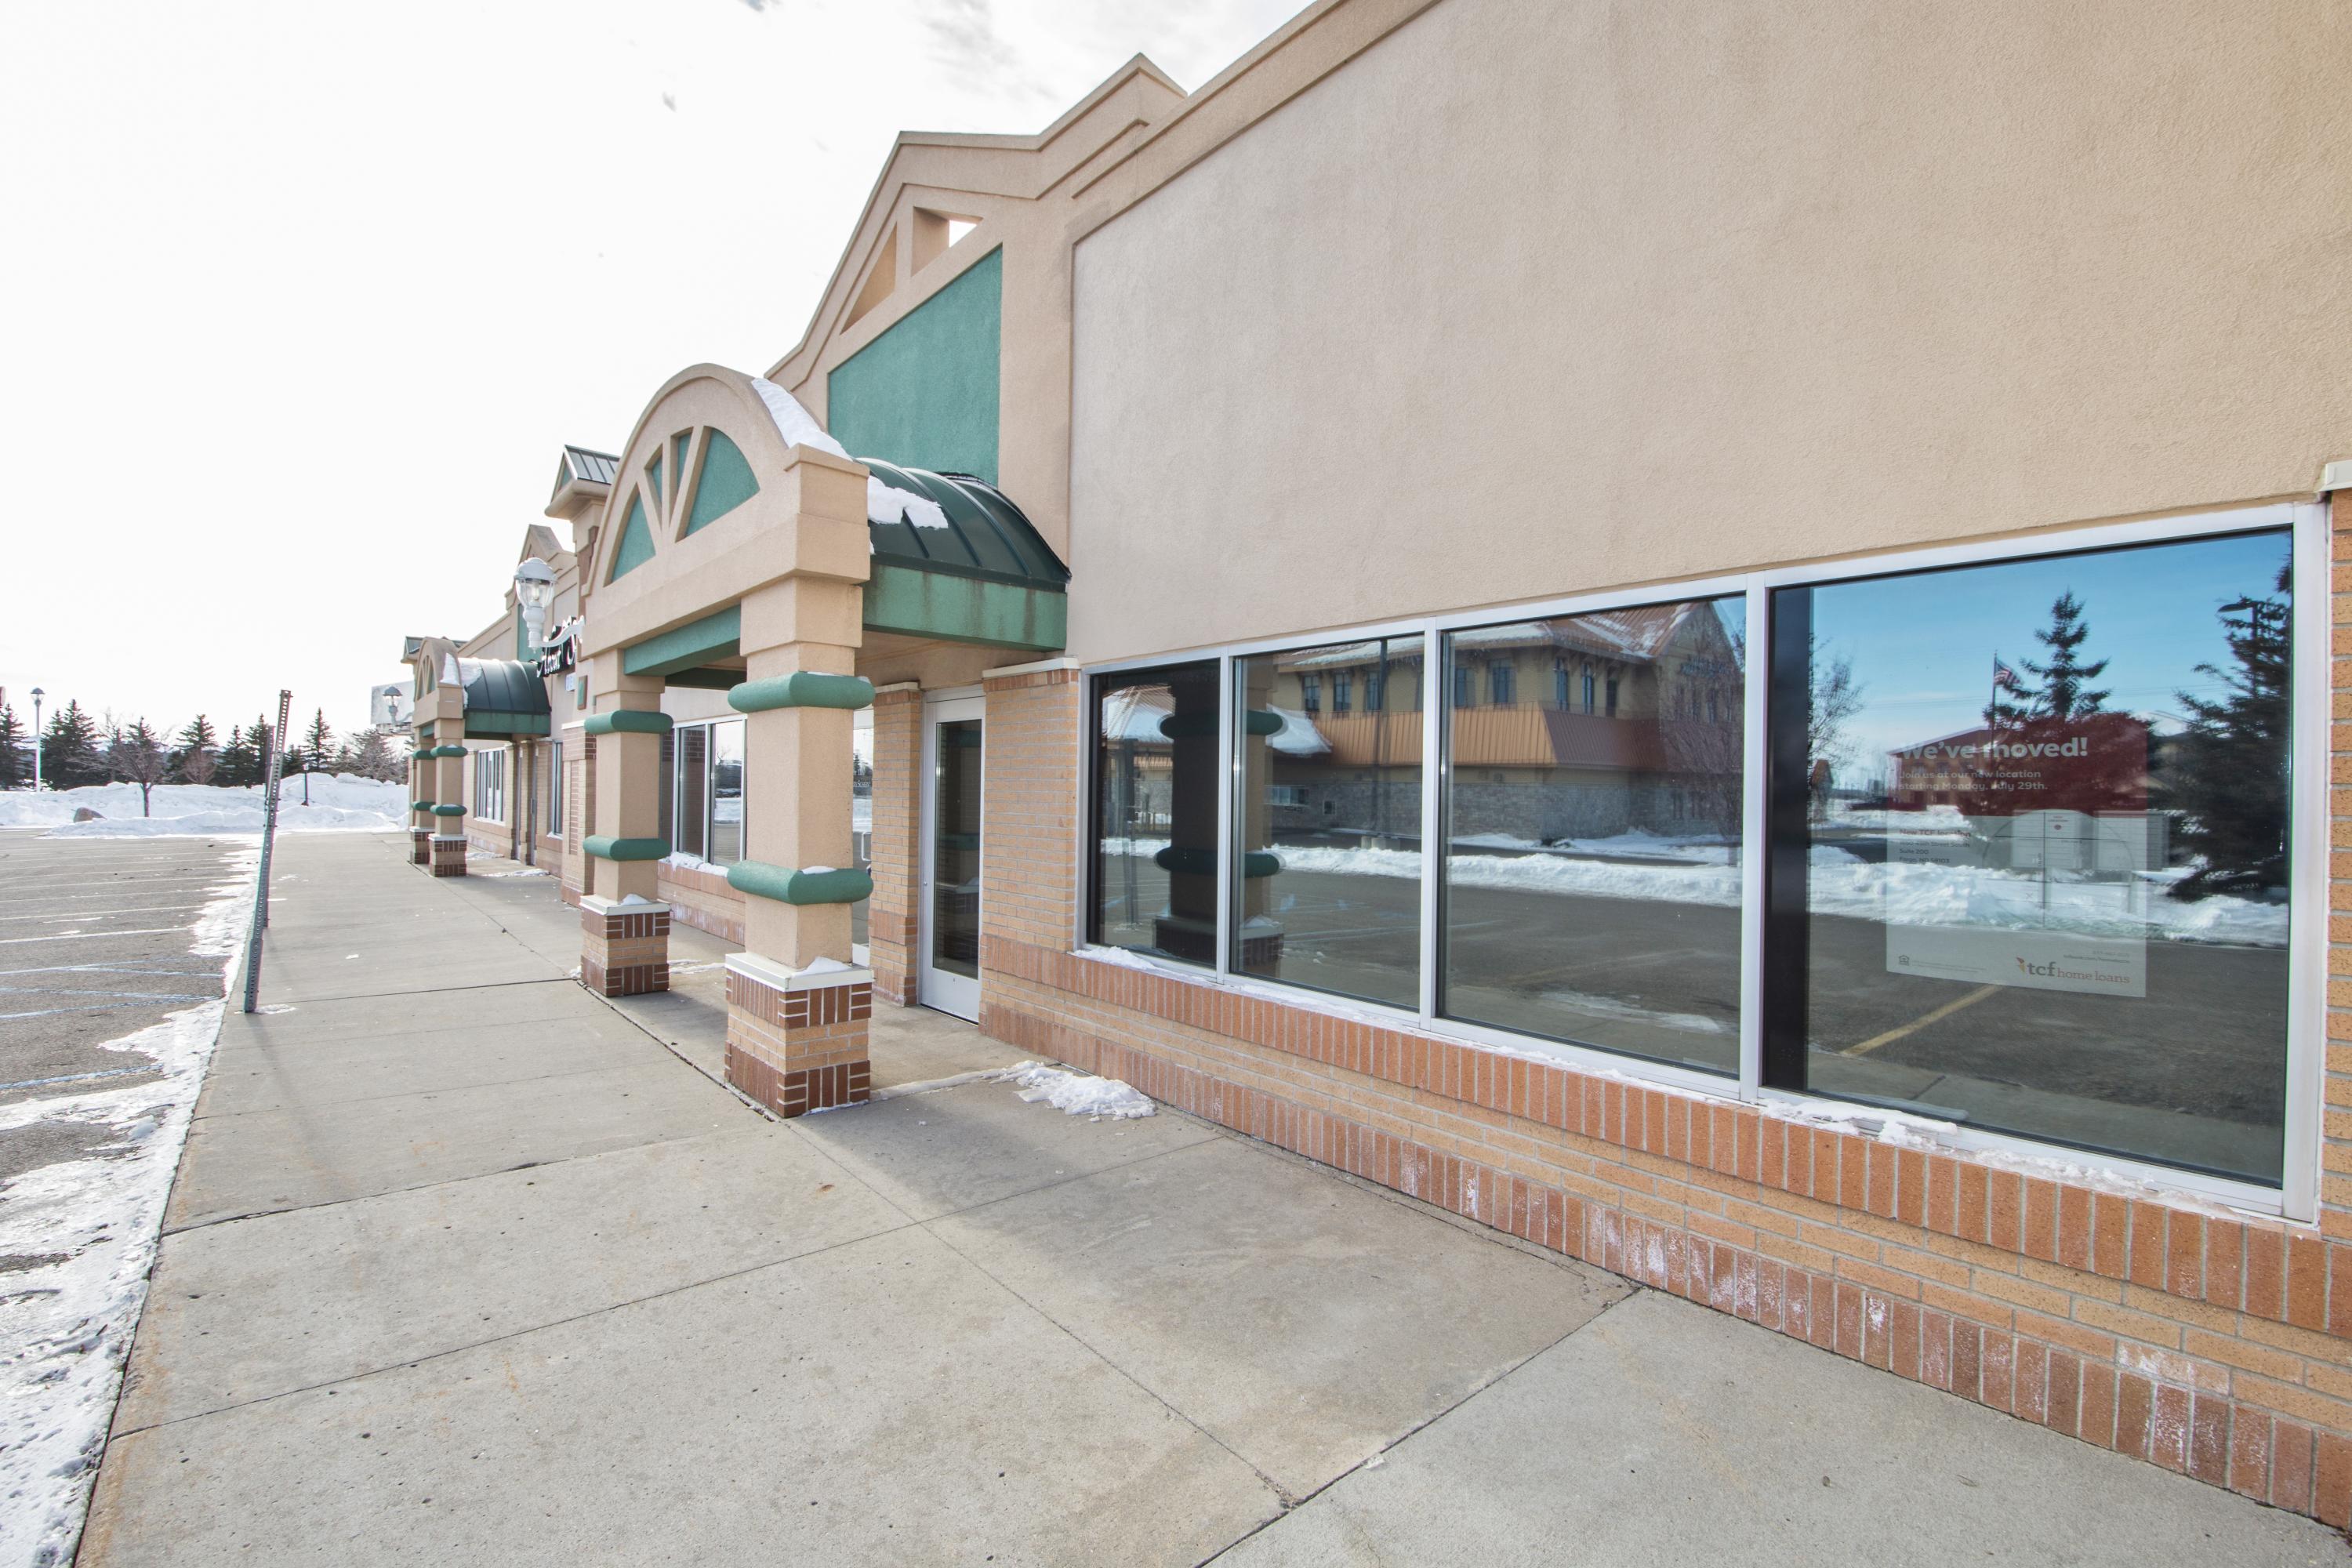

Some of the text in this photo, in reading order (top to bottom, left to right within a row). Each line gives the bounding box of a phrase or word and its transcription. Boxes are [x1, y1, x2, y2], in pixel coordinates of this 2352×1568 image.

[1901, 736, 2088, 760] We've moved!
[1995, 769, 2042, 779] location
[2017, 781, 2049, 790] 29th.
[2027, 961, 2130, 984] tcf home loans
